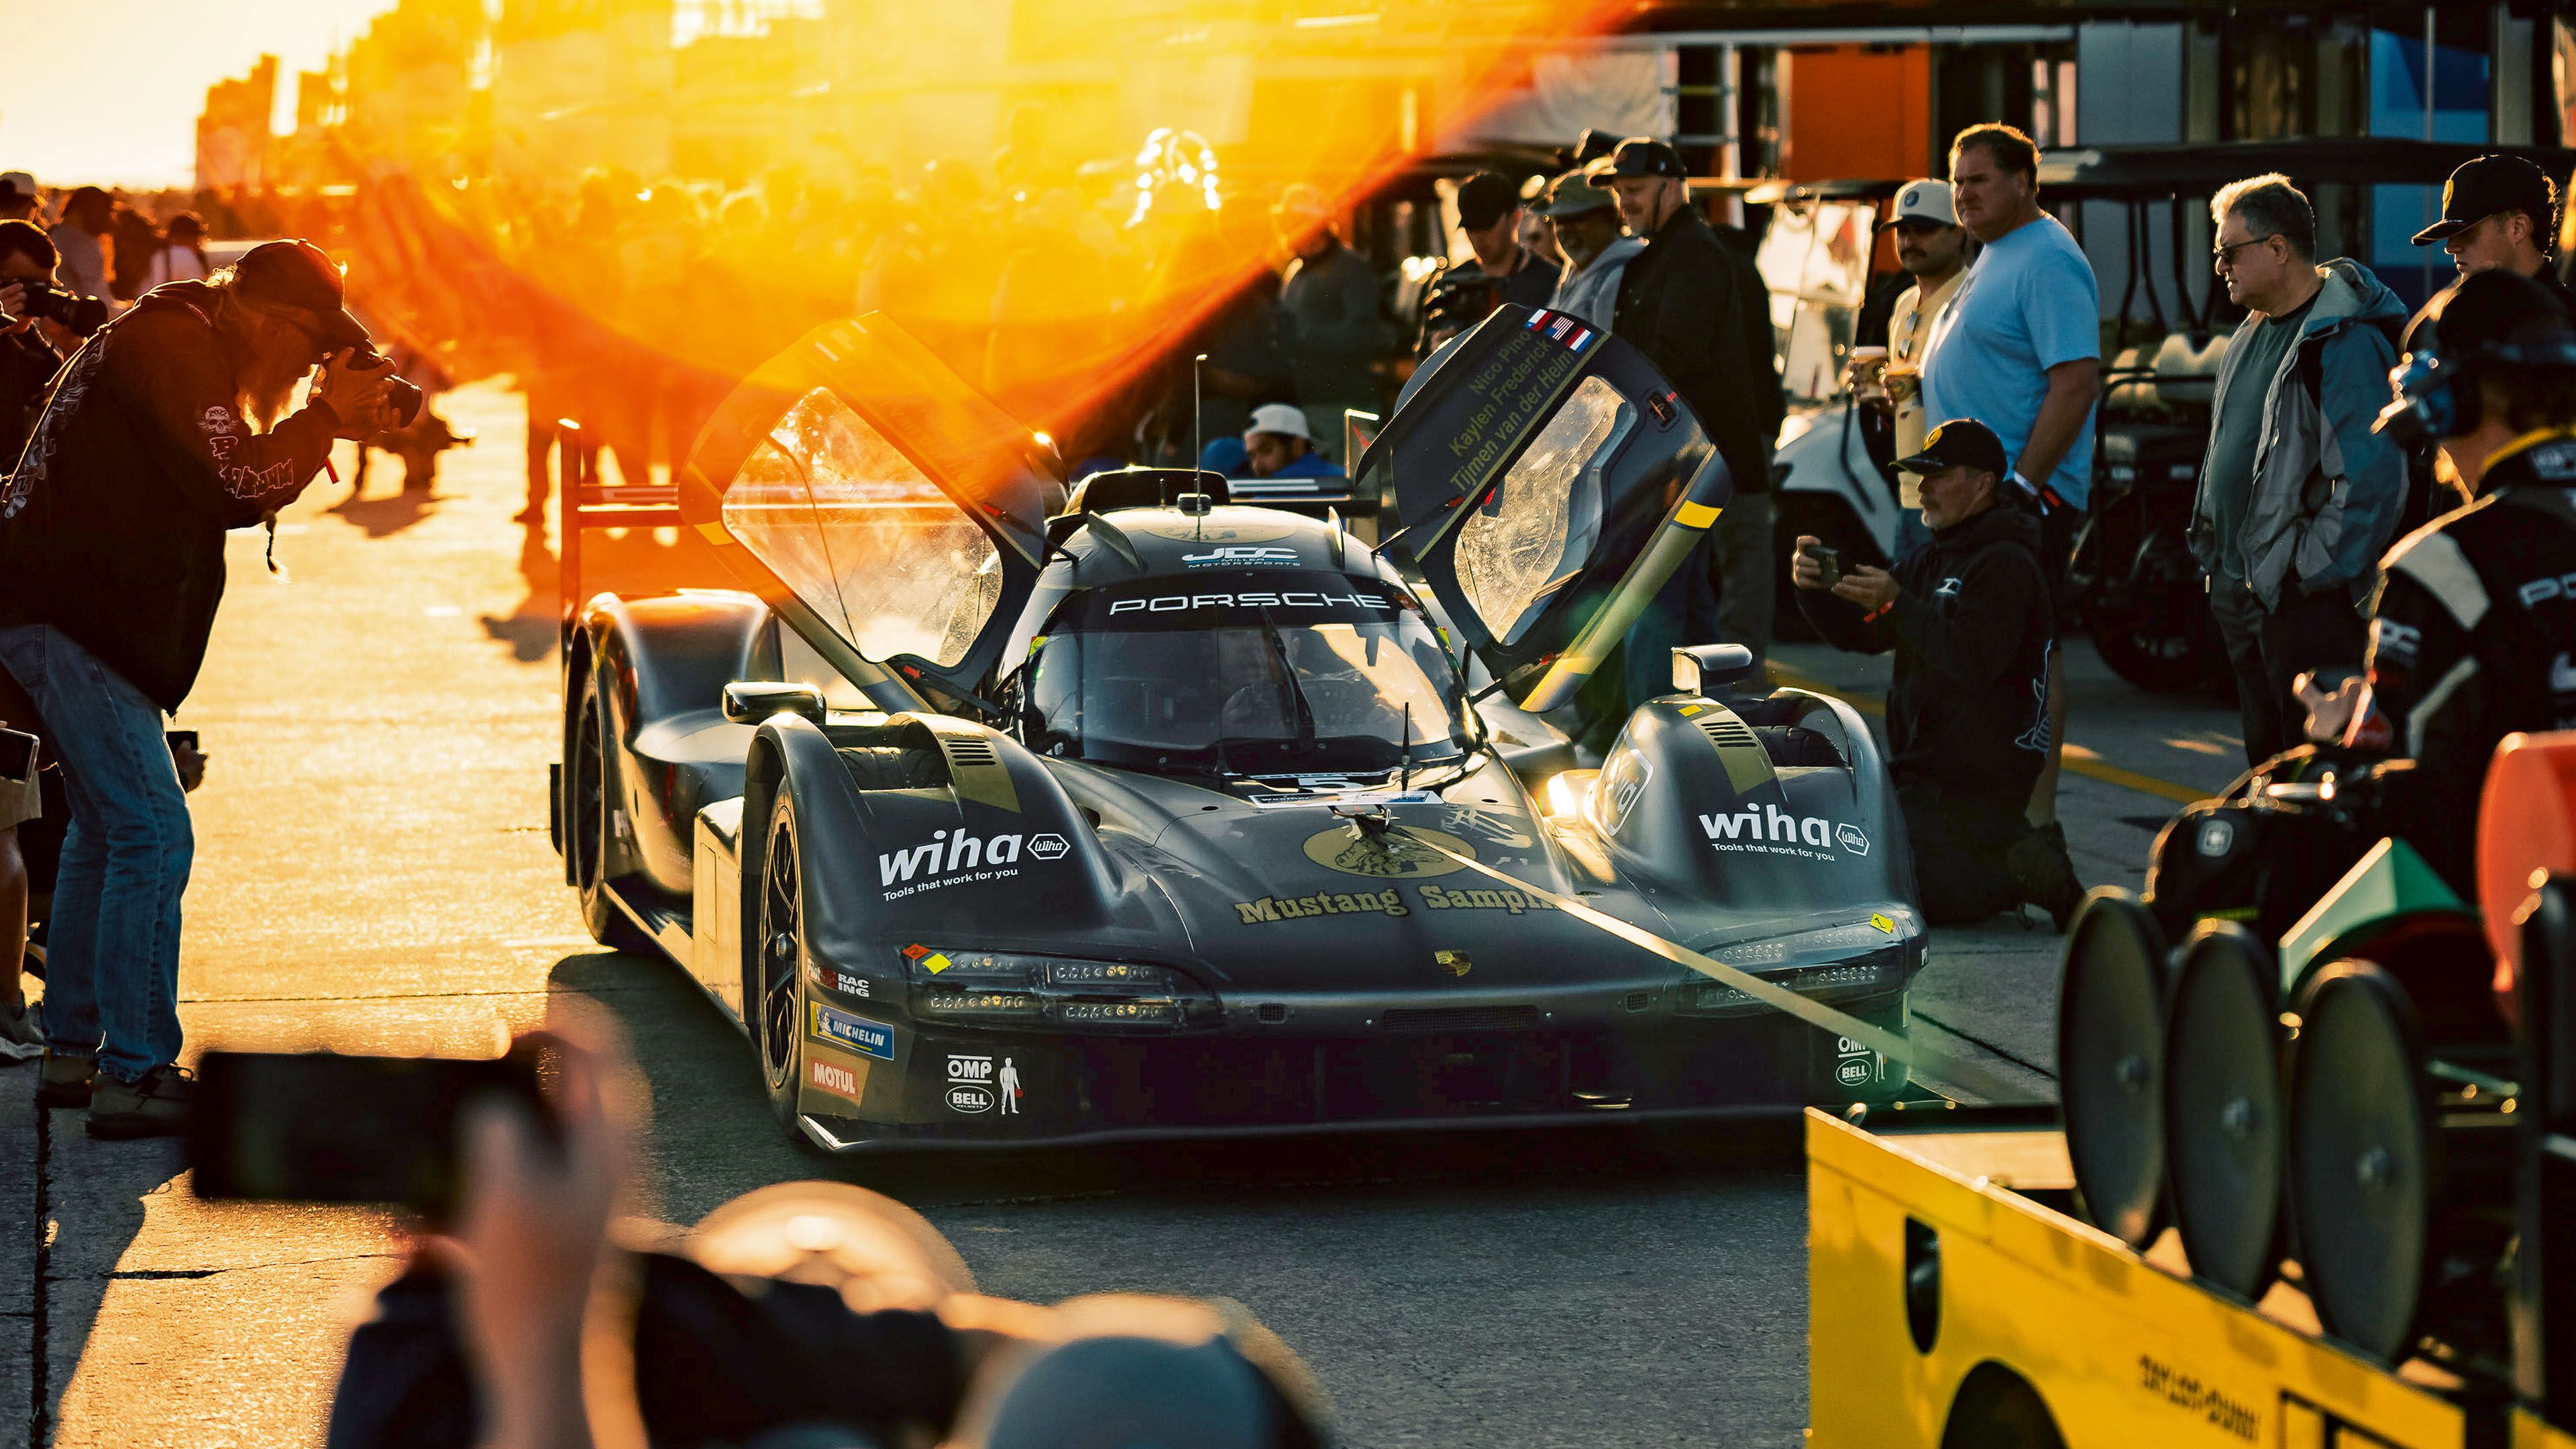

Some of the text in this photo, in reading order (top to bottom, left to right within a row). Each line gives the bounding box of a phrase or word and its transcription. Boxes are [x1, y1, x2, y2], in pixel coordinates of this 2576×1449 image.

[1469, 331, 1532, 395] Nico Pino
[1449, 339, 1553, 458] Kaylen Frederick
[1450, 351, 1574, 492] Tijmen van der Helm
[1182, 547, 1299, 561] JDC
[1188, 561, 1301, 569] MOTORSPORTS
[1110, 592, 1391, 616] PORSCHE
[1699, 802, 1831, 848] wiha
[879, 828, 1023, 886] wiha
[1711, 843, 1835, 862] Tools that work for you
[883, 869, 1018, 902] Tools that work for you
[1236, 889, 1409, 924] Mustang
[838, 973, 869, 988] RAC
[838, 981, 870, 998] ING
[833, 1020, 885, 1047] MICHELIN
[814, 1062, 856, 1094] MOTUL
[947, 1060, 992, 1079] OMP
[1841, 1065, 1867, 1079] BELL
[953, 1092, 987, 1106] BELL
